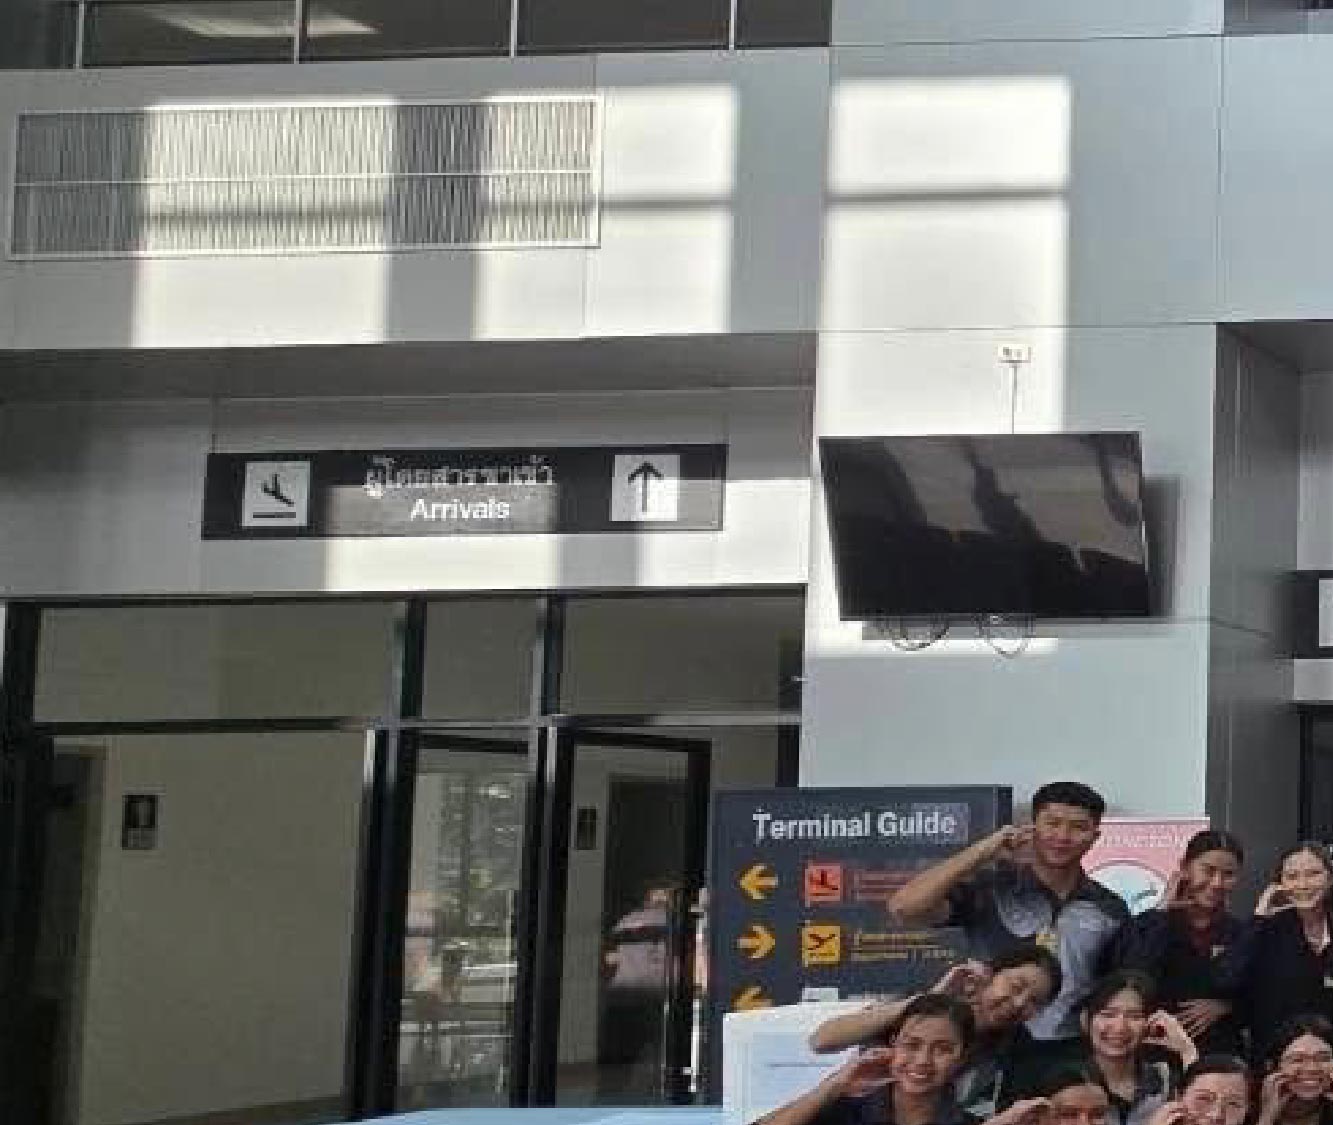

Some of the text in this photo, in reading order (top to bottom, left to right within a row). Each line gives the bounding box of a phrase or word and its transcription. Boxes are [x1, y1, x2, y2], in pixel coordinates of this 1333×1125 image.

[410, 497, 511, 520] Arrivals
[752, 810, 958, 841] Terminal Guide
